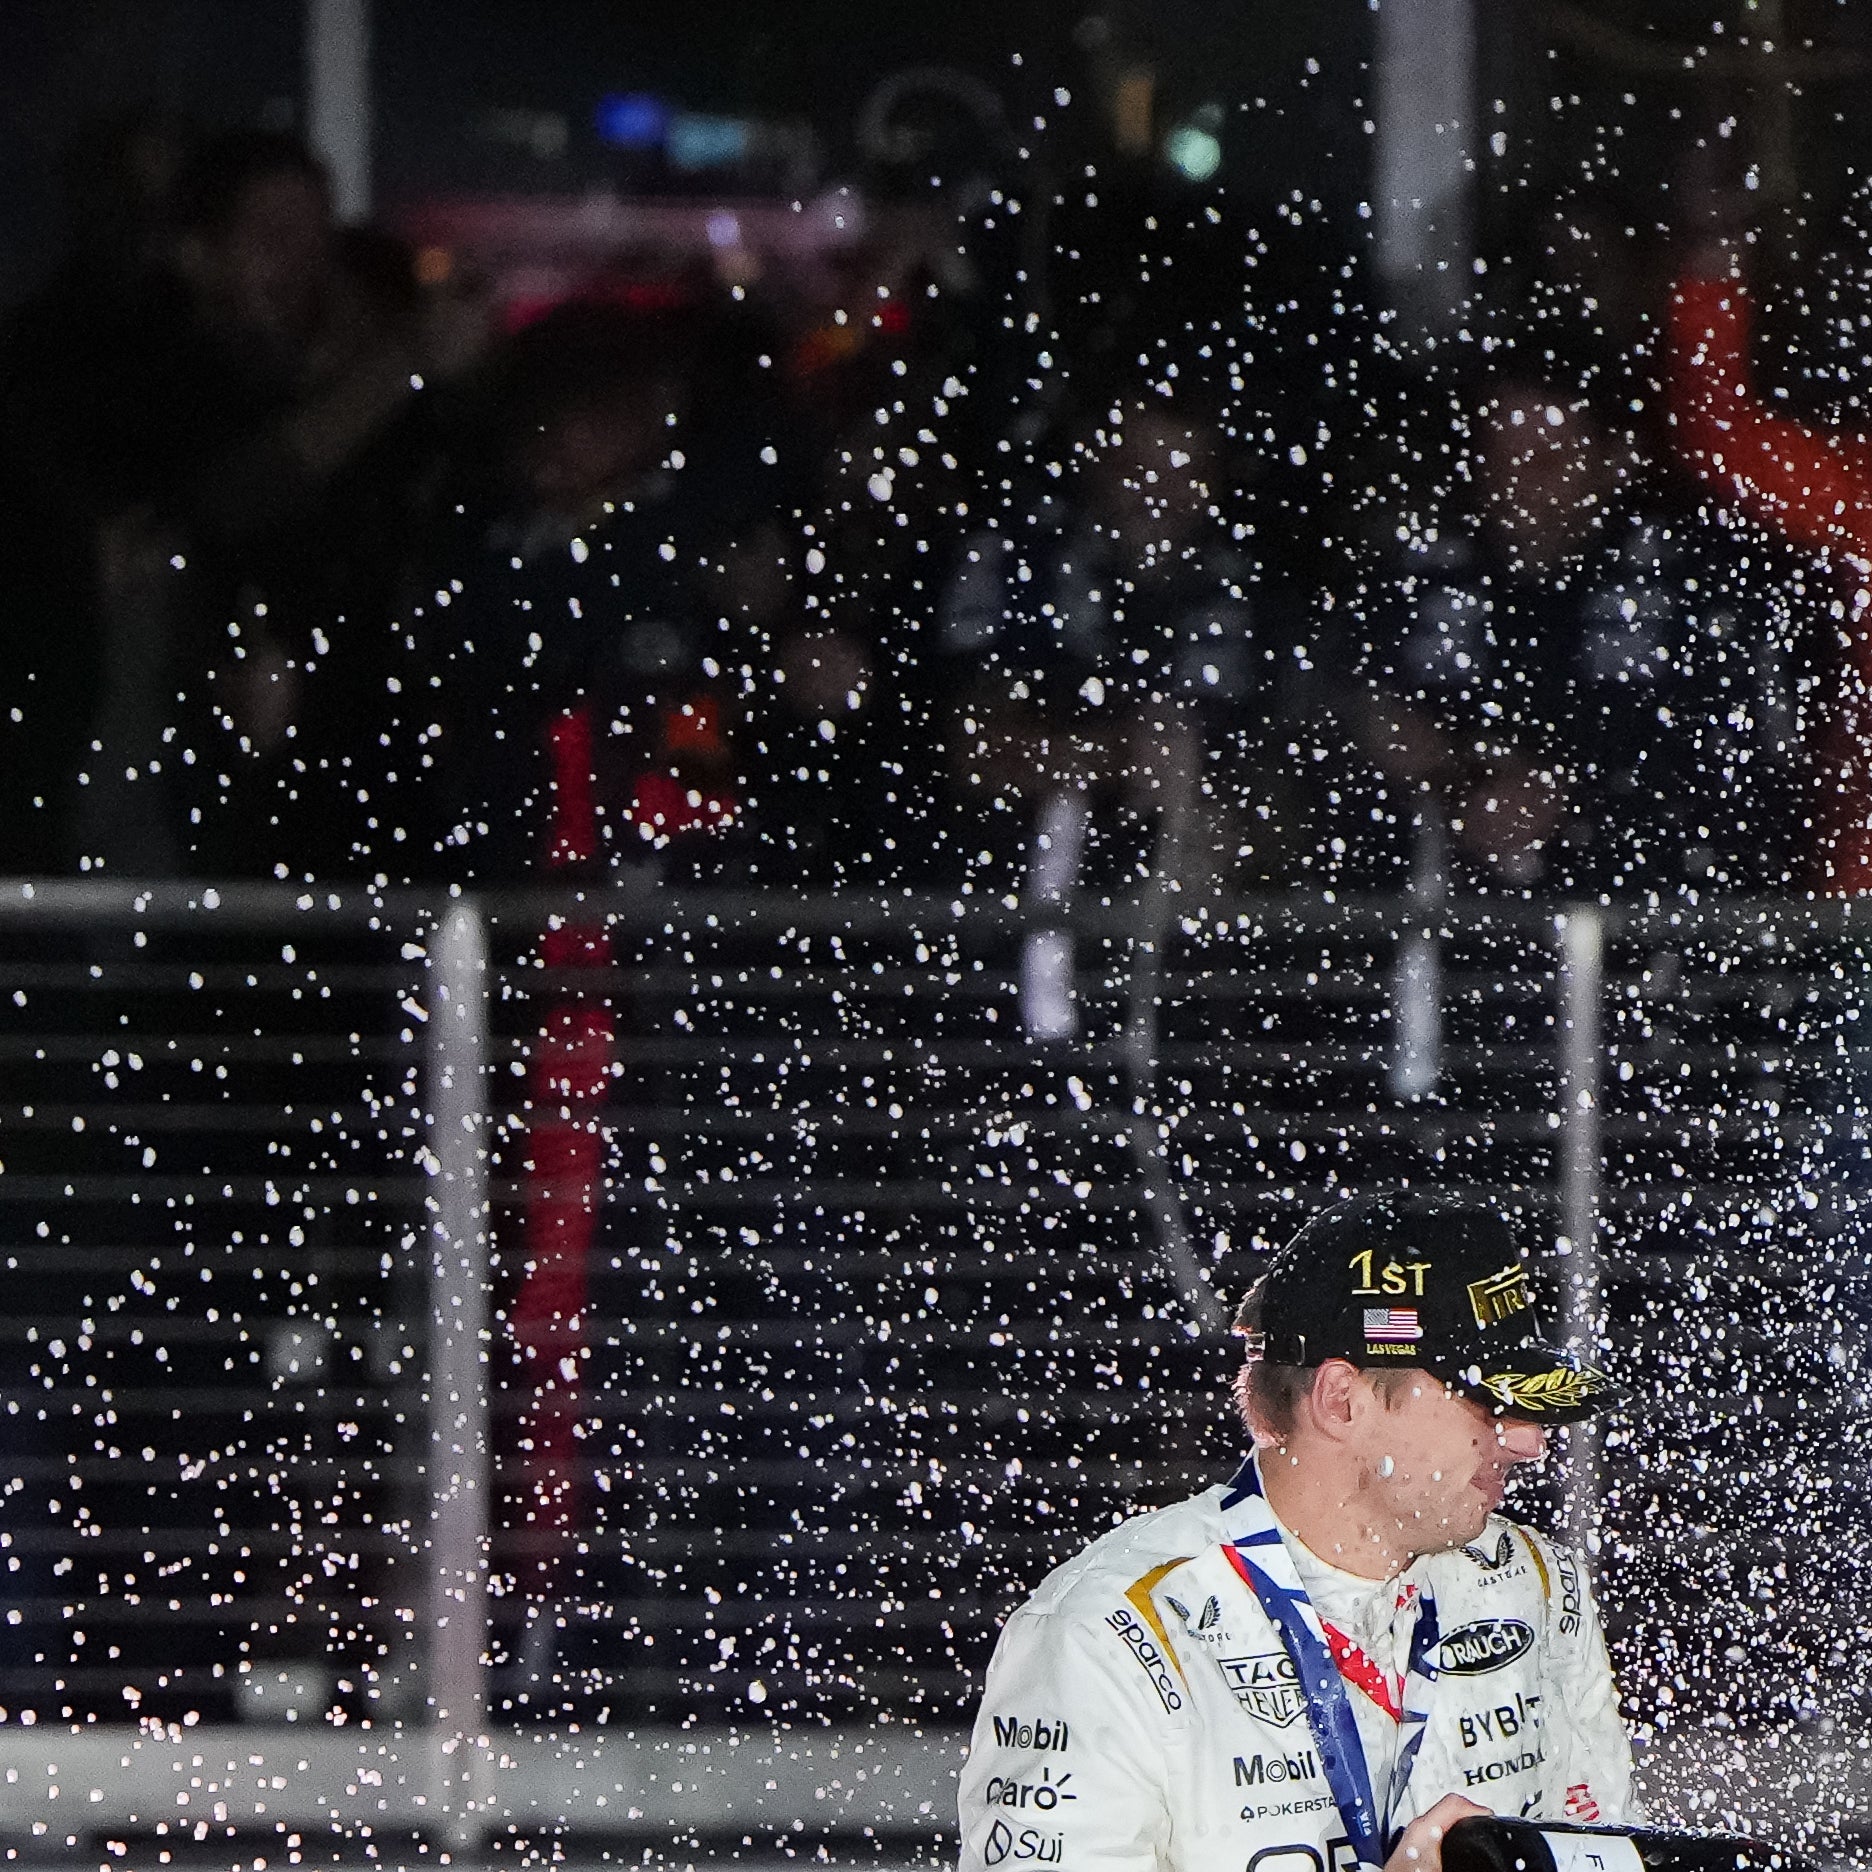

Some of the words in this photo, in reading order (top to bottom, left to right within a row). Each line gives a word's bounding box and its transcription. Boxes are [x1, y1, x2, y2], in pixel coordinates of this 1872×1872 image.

[1349, 1249, 1432, 1296] 1ST
[1367, 1343, 1390, 1355] LAS
[1105, 1609, 1182, 1714] sparco
[1451, 1627, 1523, 1664] RAUCH
[993, 1715, 1068, 1752] Mobil
[1459, 1692, 1544, 1749] BYBIT
[1233, 1750, 1316, 1787] Mobil
[1463, 1751, 1545, 1787] HONDA
[1258, 1796, 1337, 1819] POKERSTA
[1014, 1829, 1064, 1864] Sui
